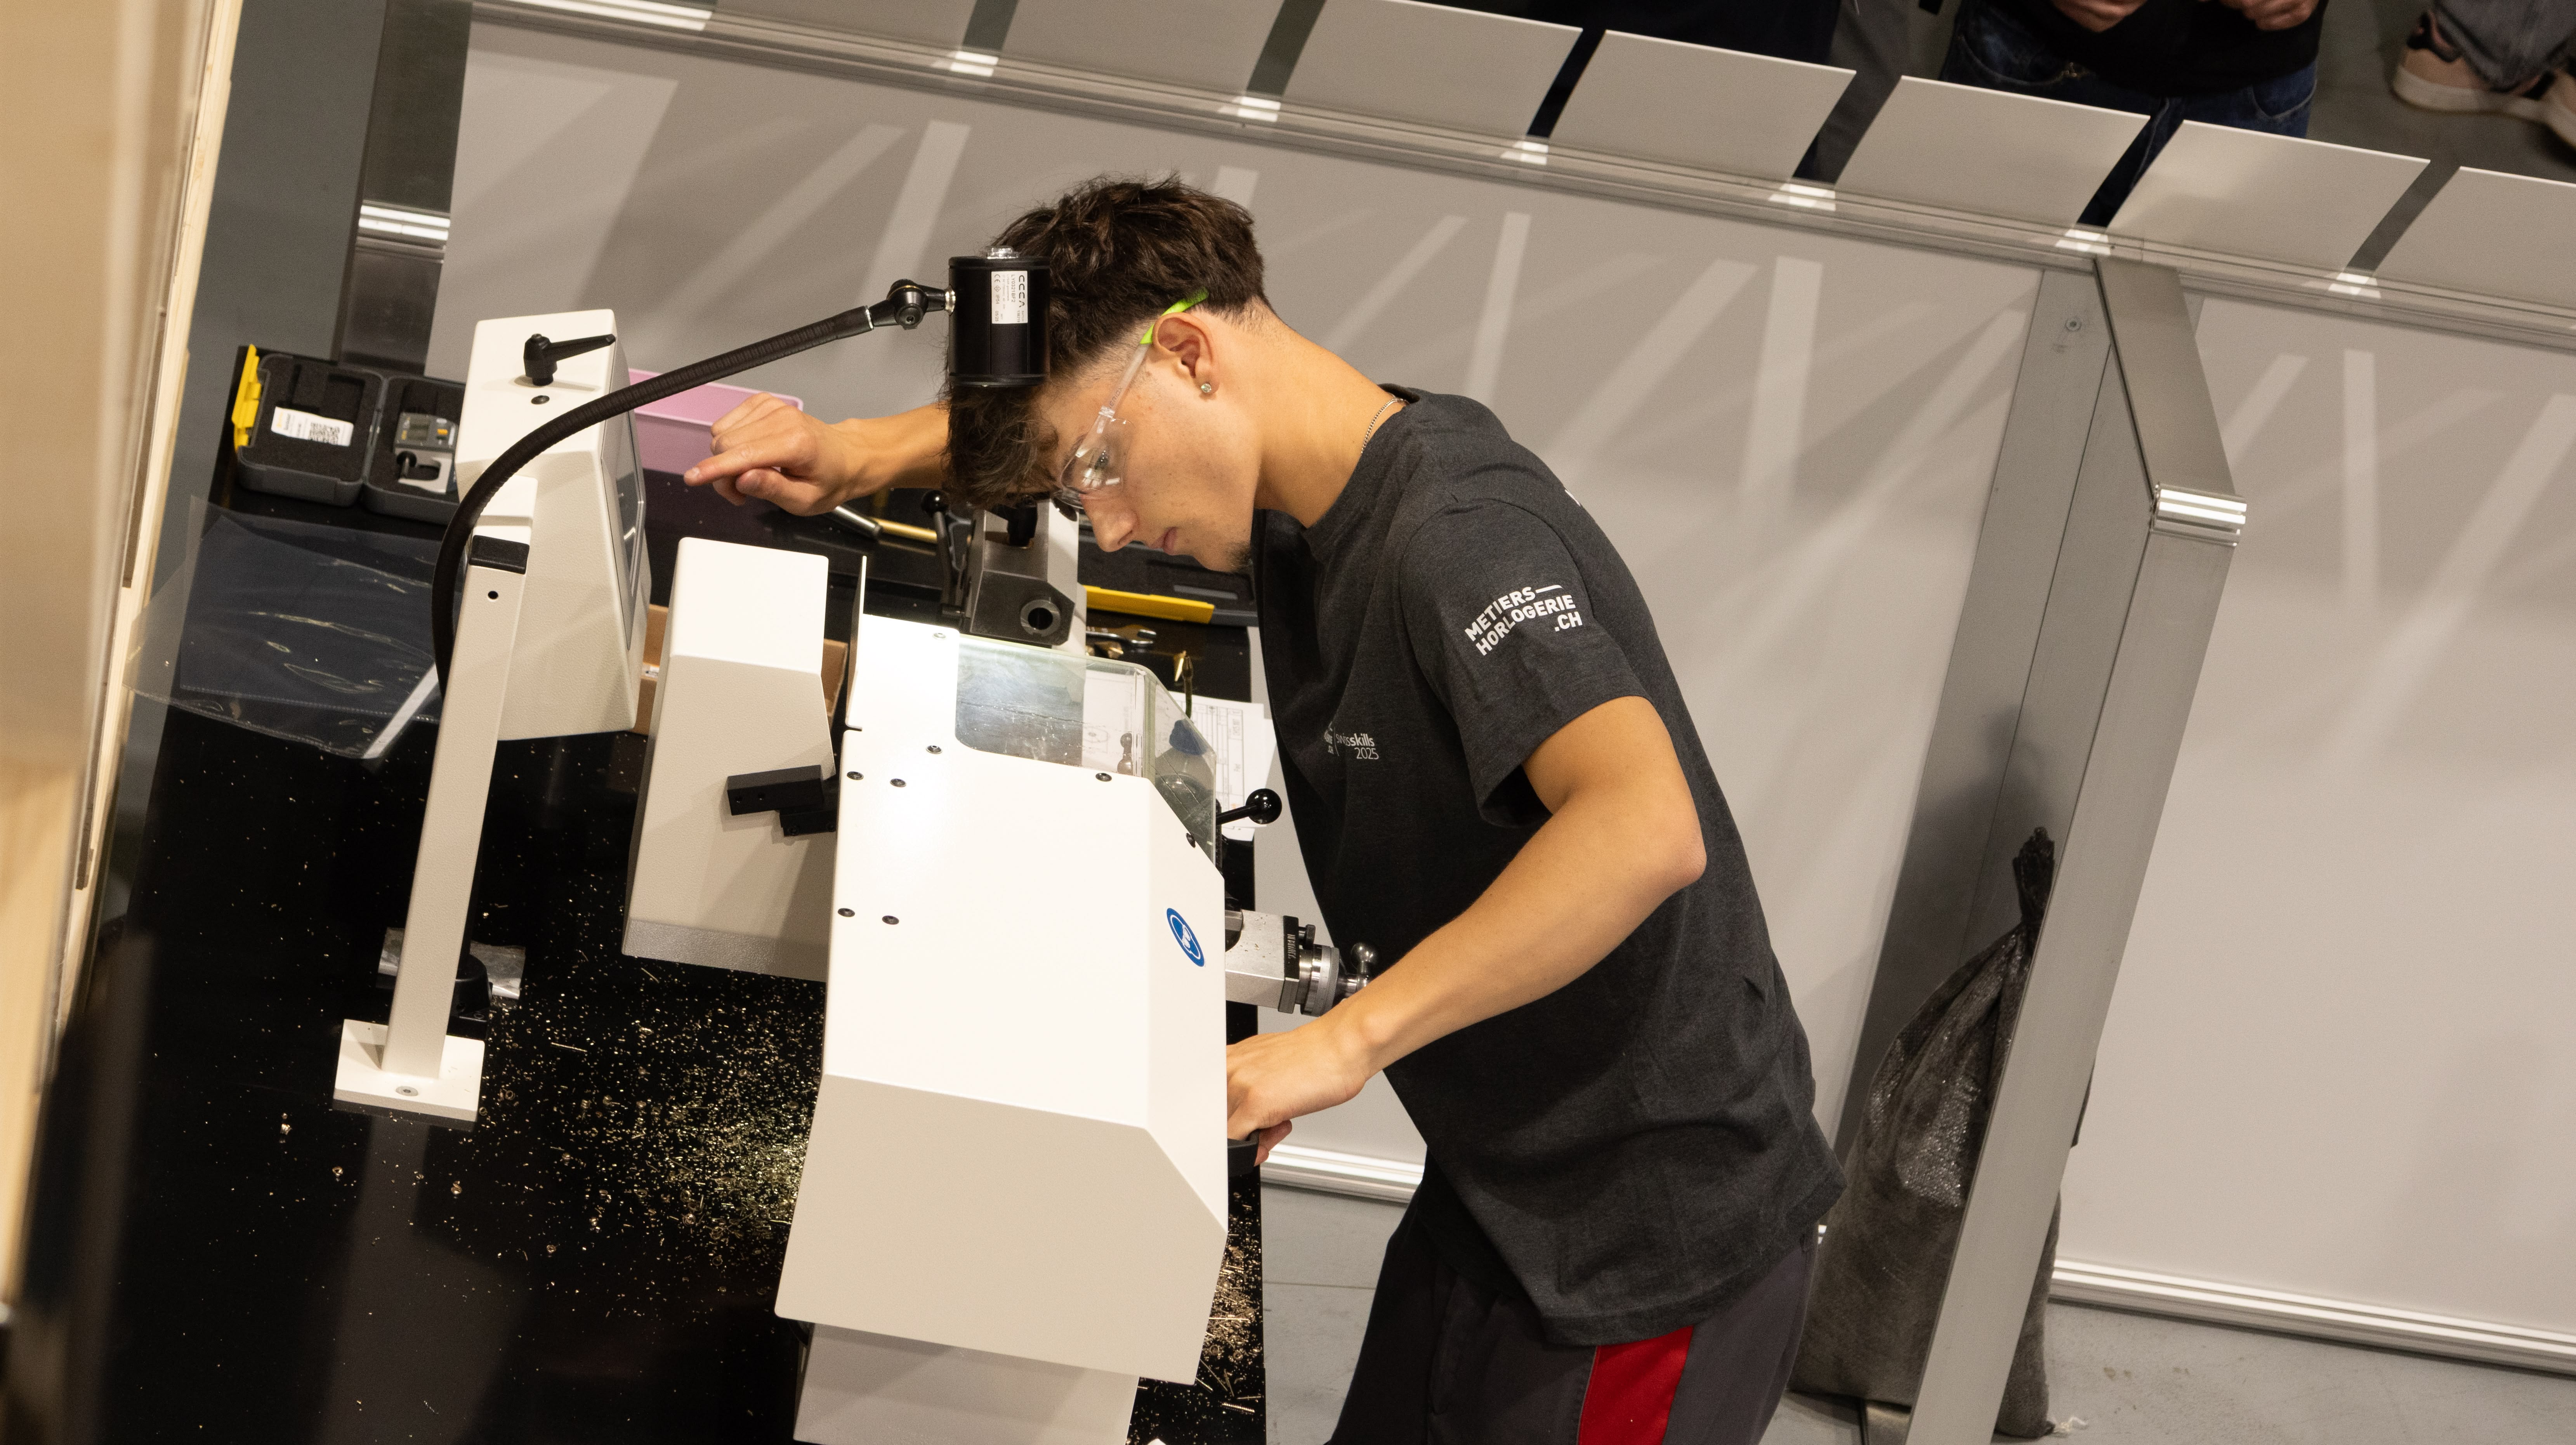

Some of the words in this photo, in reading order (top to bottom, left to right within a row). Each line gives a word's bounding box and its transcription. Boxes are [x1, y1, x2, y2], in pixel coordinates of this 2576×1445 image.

[1475, 594, 1576, 656] HORLOGERIE
[1555, 611, 1583, 632] .CH
[1354, 747, 1379, 759] 2025
